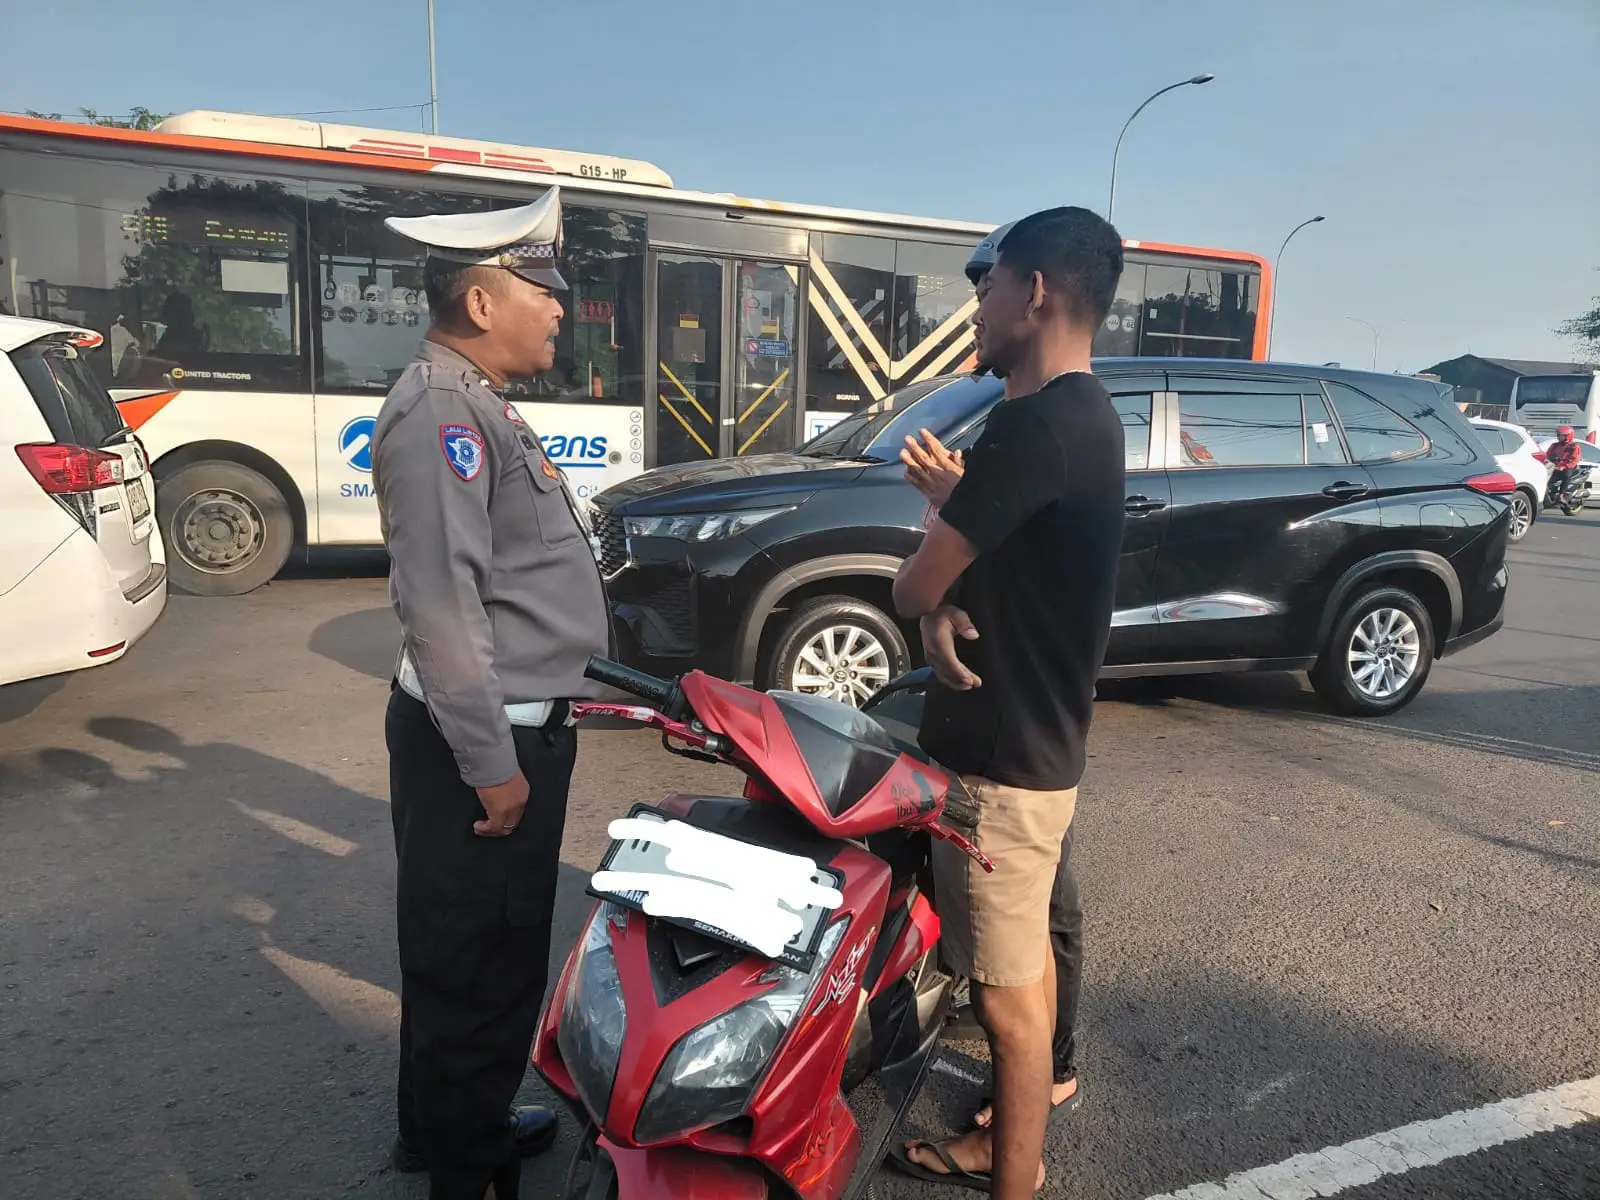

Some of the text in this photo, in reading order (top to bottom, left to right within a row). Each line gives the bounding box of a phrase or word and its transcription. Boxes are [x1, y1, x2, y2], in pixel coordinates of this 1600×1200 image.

[579, 164, 601, 177] G15
[612, 167, 627, 180] HP
[184, 370, 251, 380] UNITED TRACTORS
